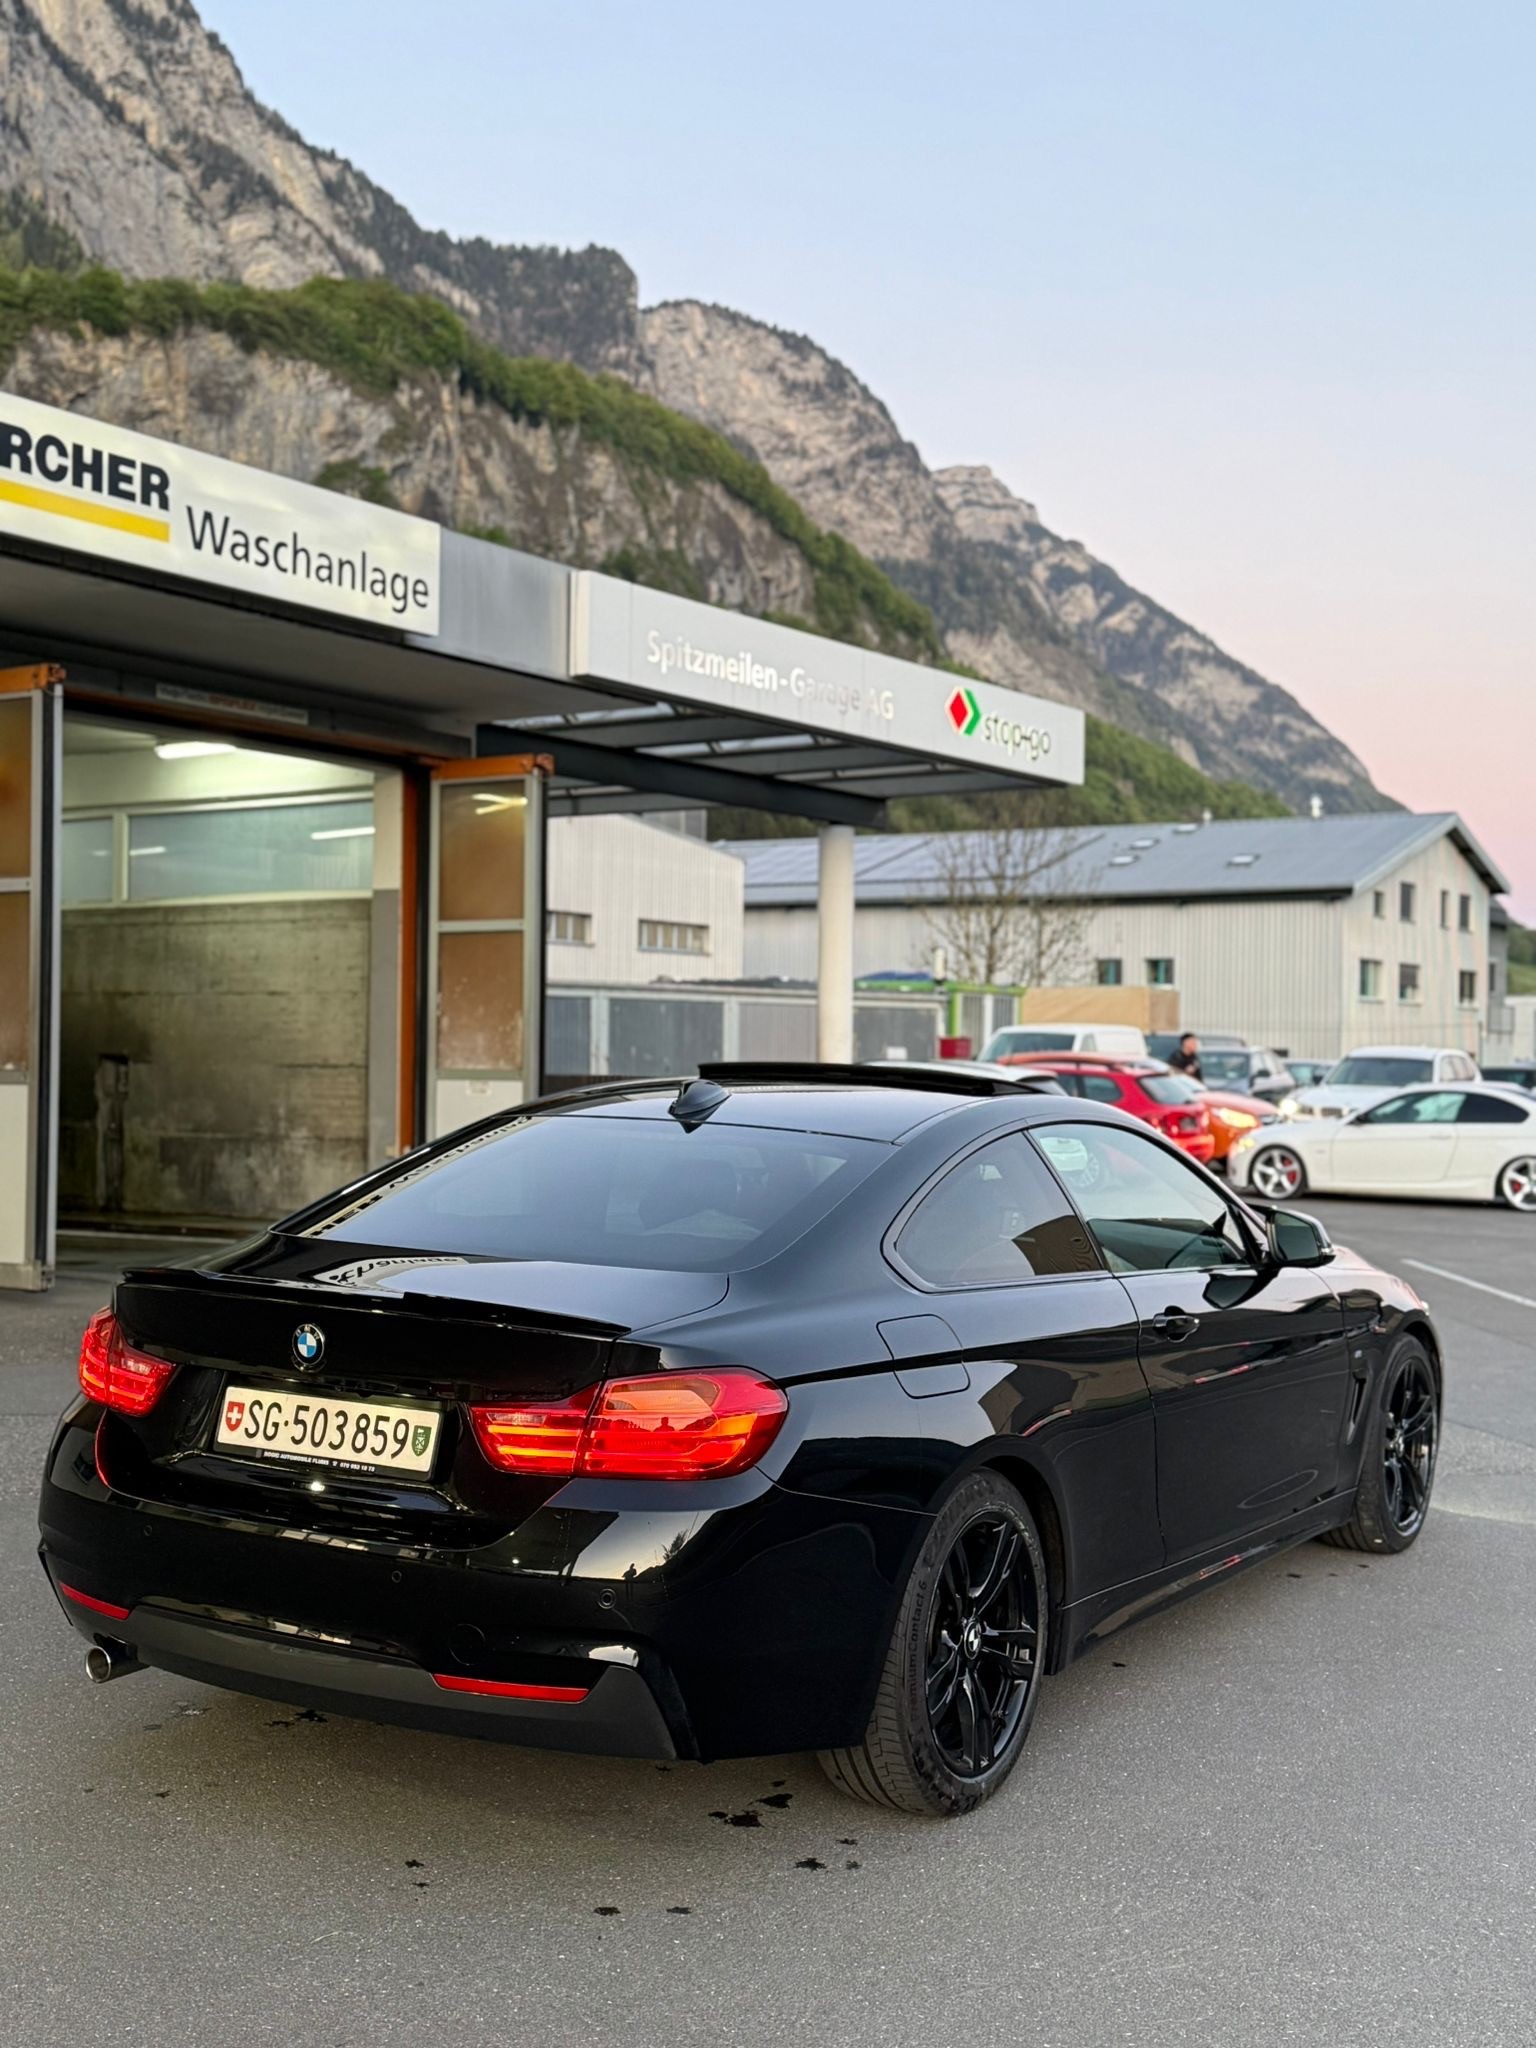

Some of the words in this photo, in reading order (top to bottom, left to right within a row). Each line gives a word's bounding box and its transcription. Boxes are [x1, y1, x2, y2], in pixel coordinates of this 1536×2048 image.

[186, 505, 430, 613] Waschanlage
[646, 629, 861, 715] Spitzmeilen-Garage
[867, 688, 895, 720] AG
